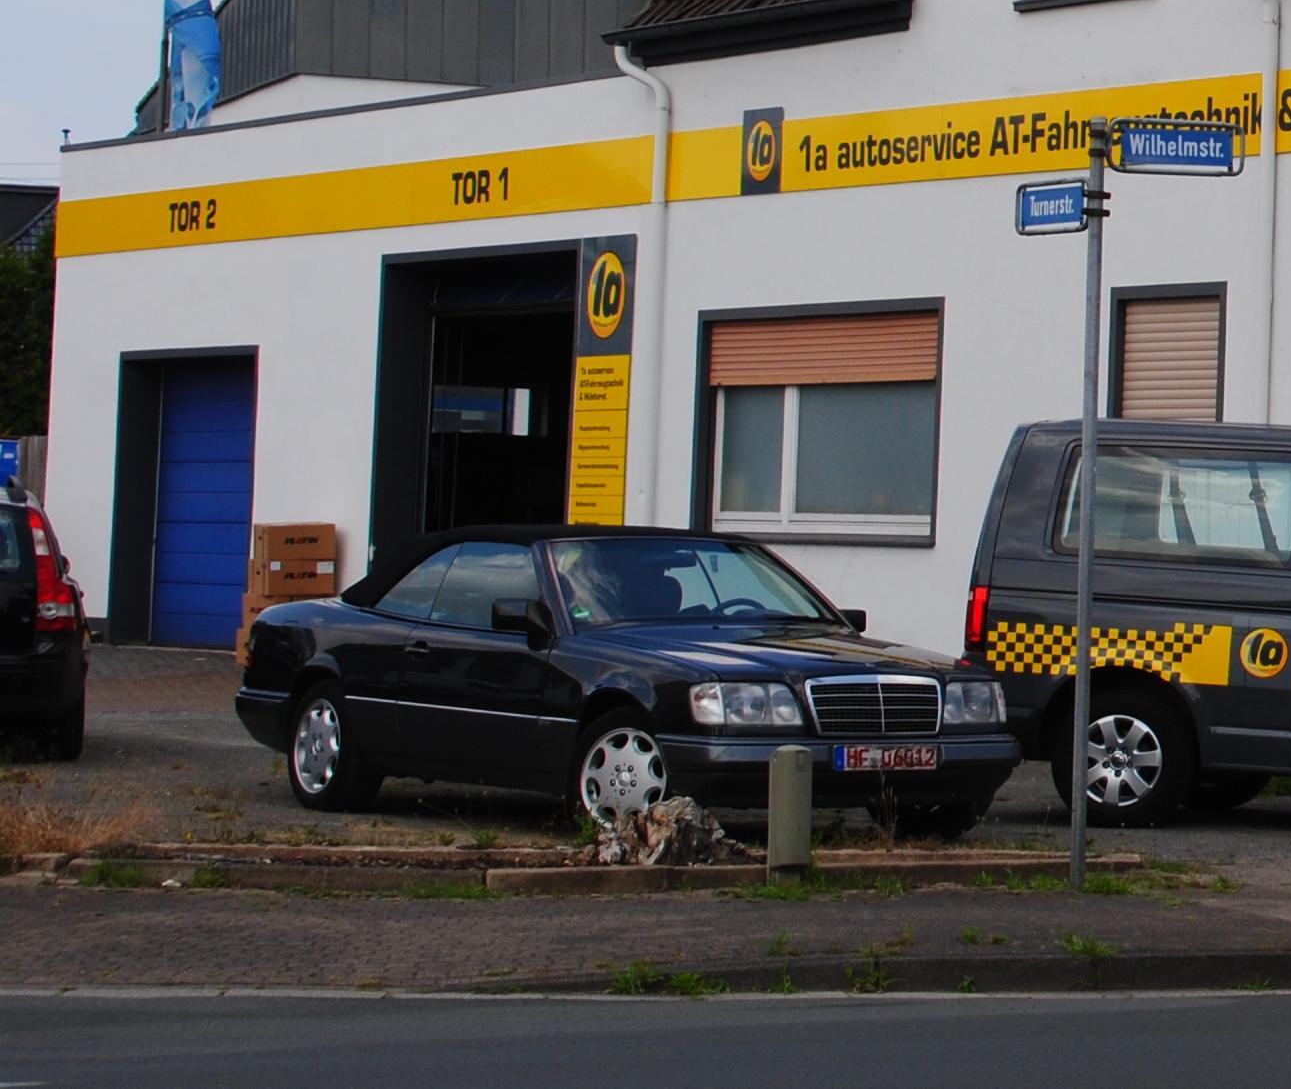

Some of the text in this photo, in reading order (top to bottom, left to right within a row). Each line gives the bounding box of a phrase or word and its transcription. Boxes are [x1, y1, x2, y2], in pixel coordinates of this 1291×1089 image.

[799, 134, 828, 173] 1a
[837, 121, 981, 170] autoservice
[1129, 132, 1225, 159] Wilhelmstr.
[451, 166, 510, 206] TOR 1
[168, 198, 217, 233] TOR 2
[1029, 195, 1075, 218] Turnerstr.
